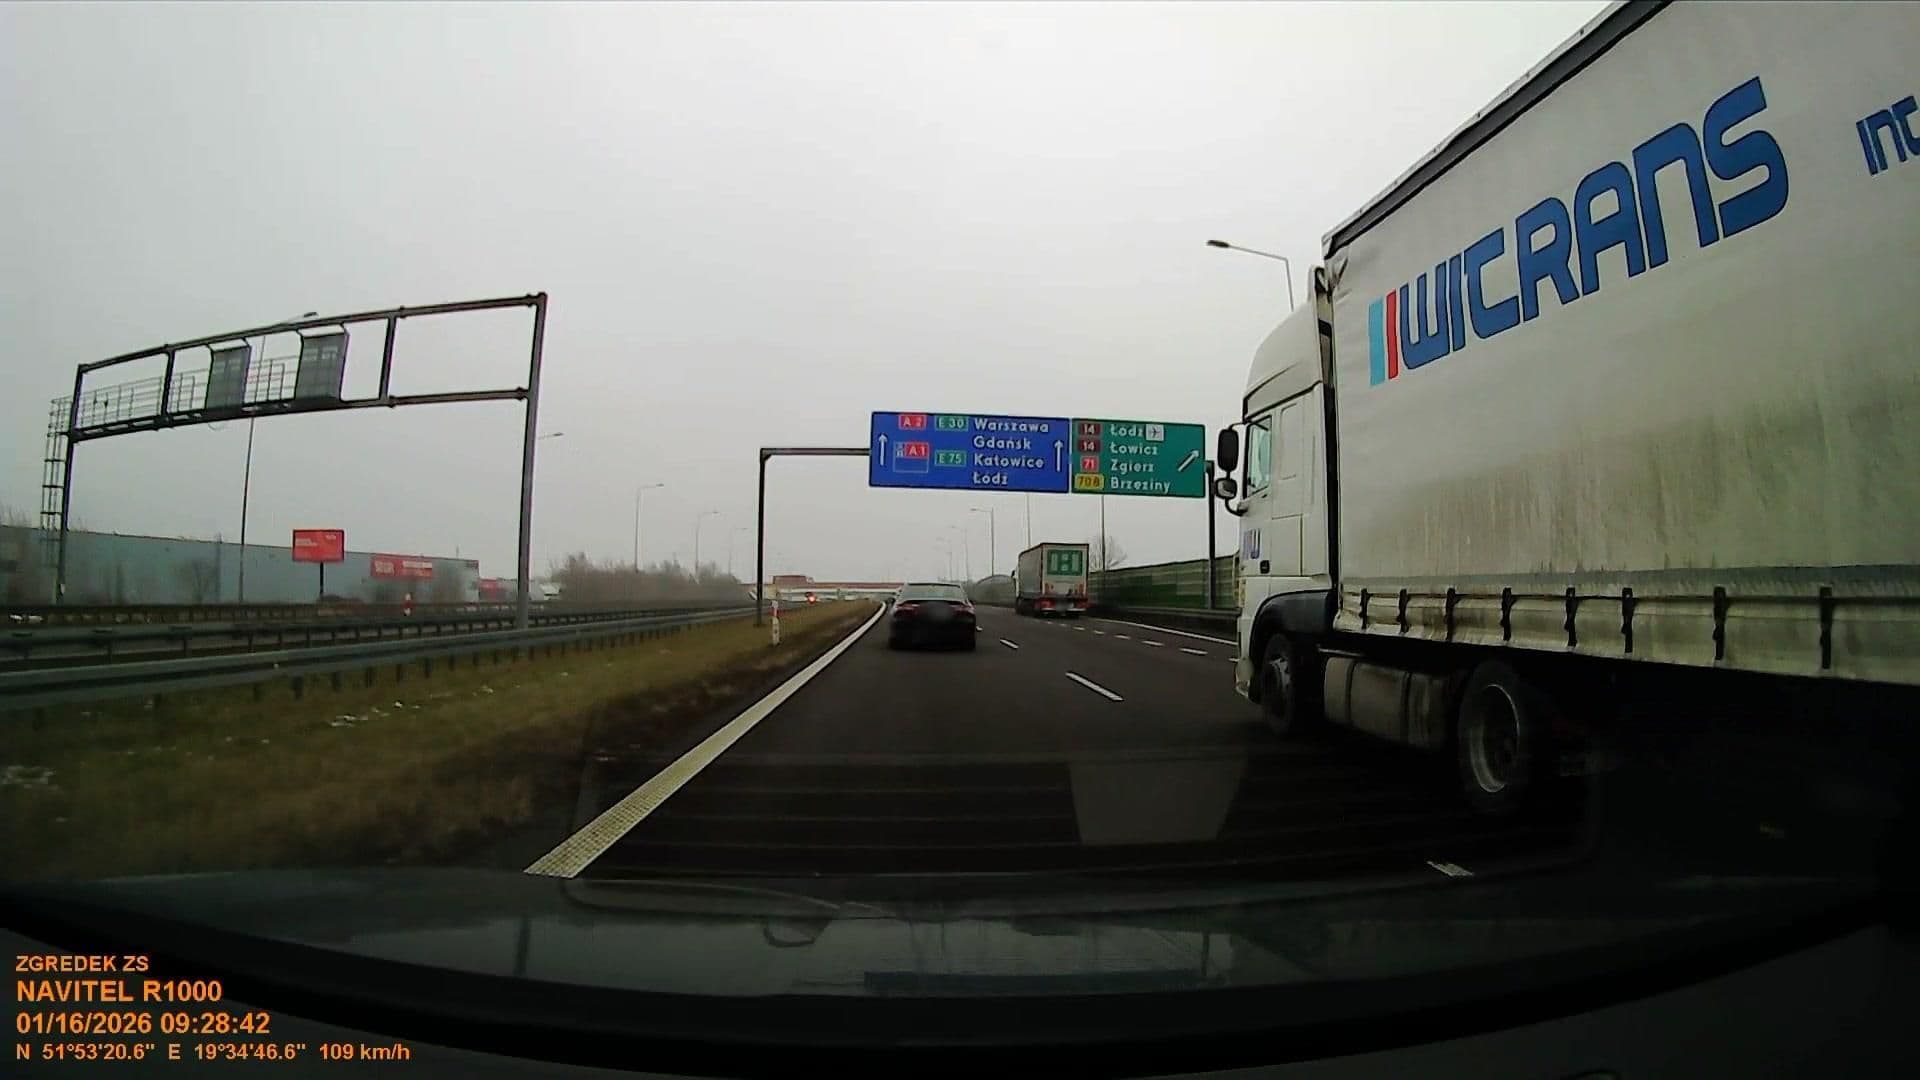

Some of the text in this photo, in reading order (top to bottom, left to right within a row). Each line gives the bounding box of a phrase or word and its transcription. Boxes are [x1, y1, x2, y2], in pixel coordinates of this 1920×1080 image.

[974, 418, 1049, 432] Warszawa
[1083, 423, 1095, 434] 14
[973, 435, 1031, 450] Gdańsk
[1083, 441, 1095, 451] 14
[1110, 442, 1158, 455] Łowicz
[974, 453, 1044, 468] Katowice
[1084, 459, 1095, 469] 71
[1111, 458, 1154, 475] Zgierz
[1110, 476, 1171, 494] Brzeziny
